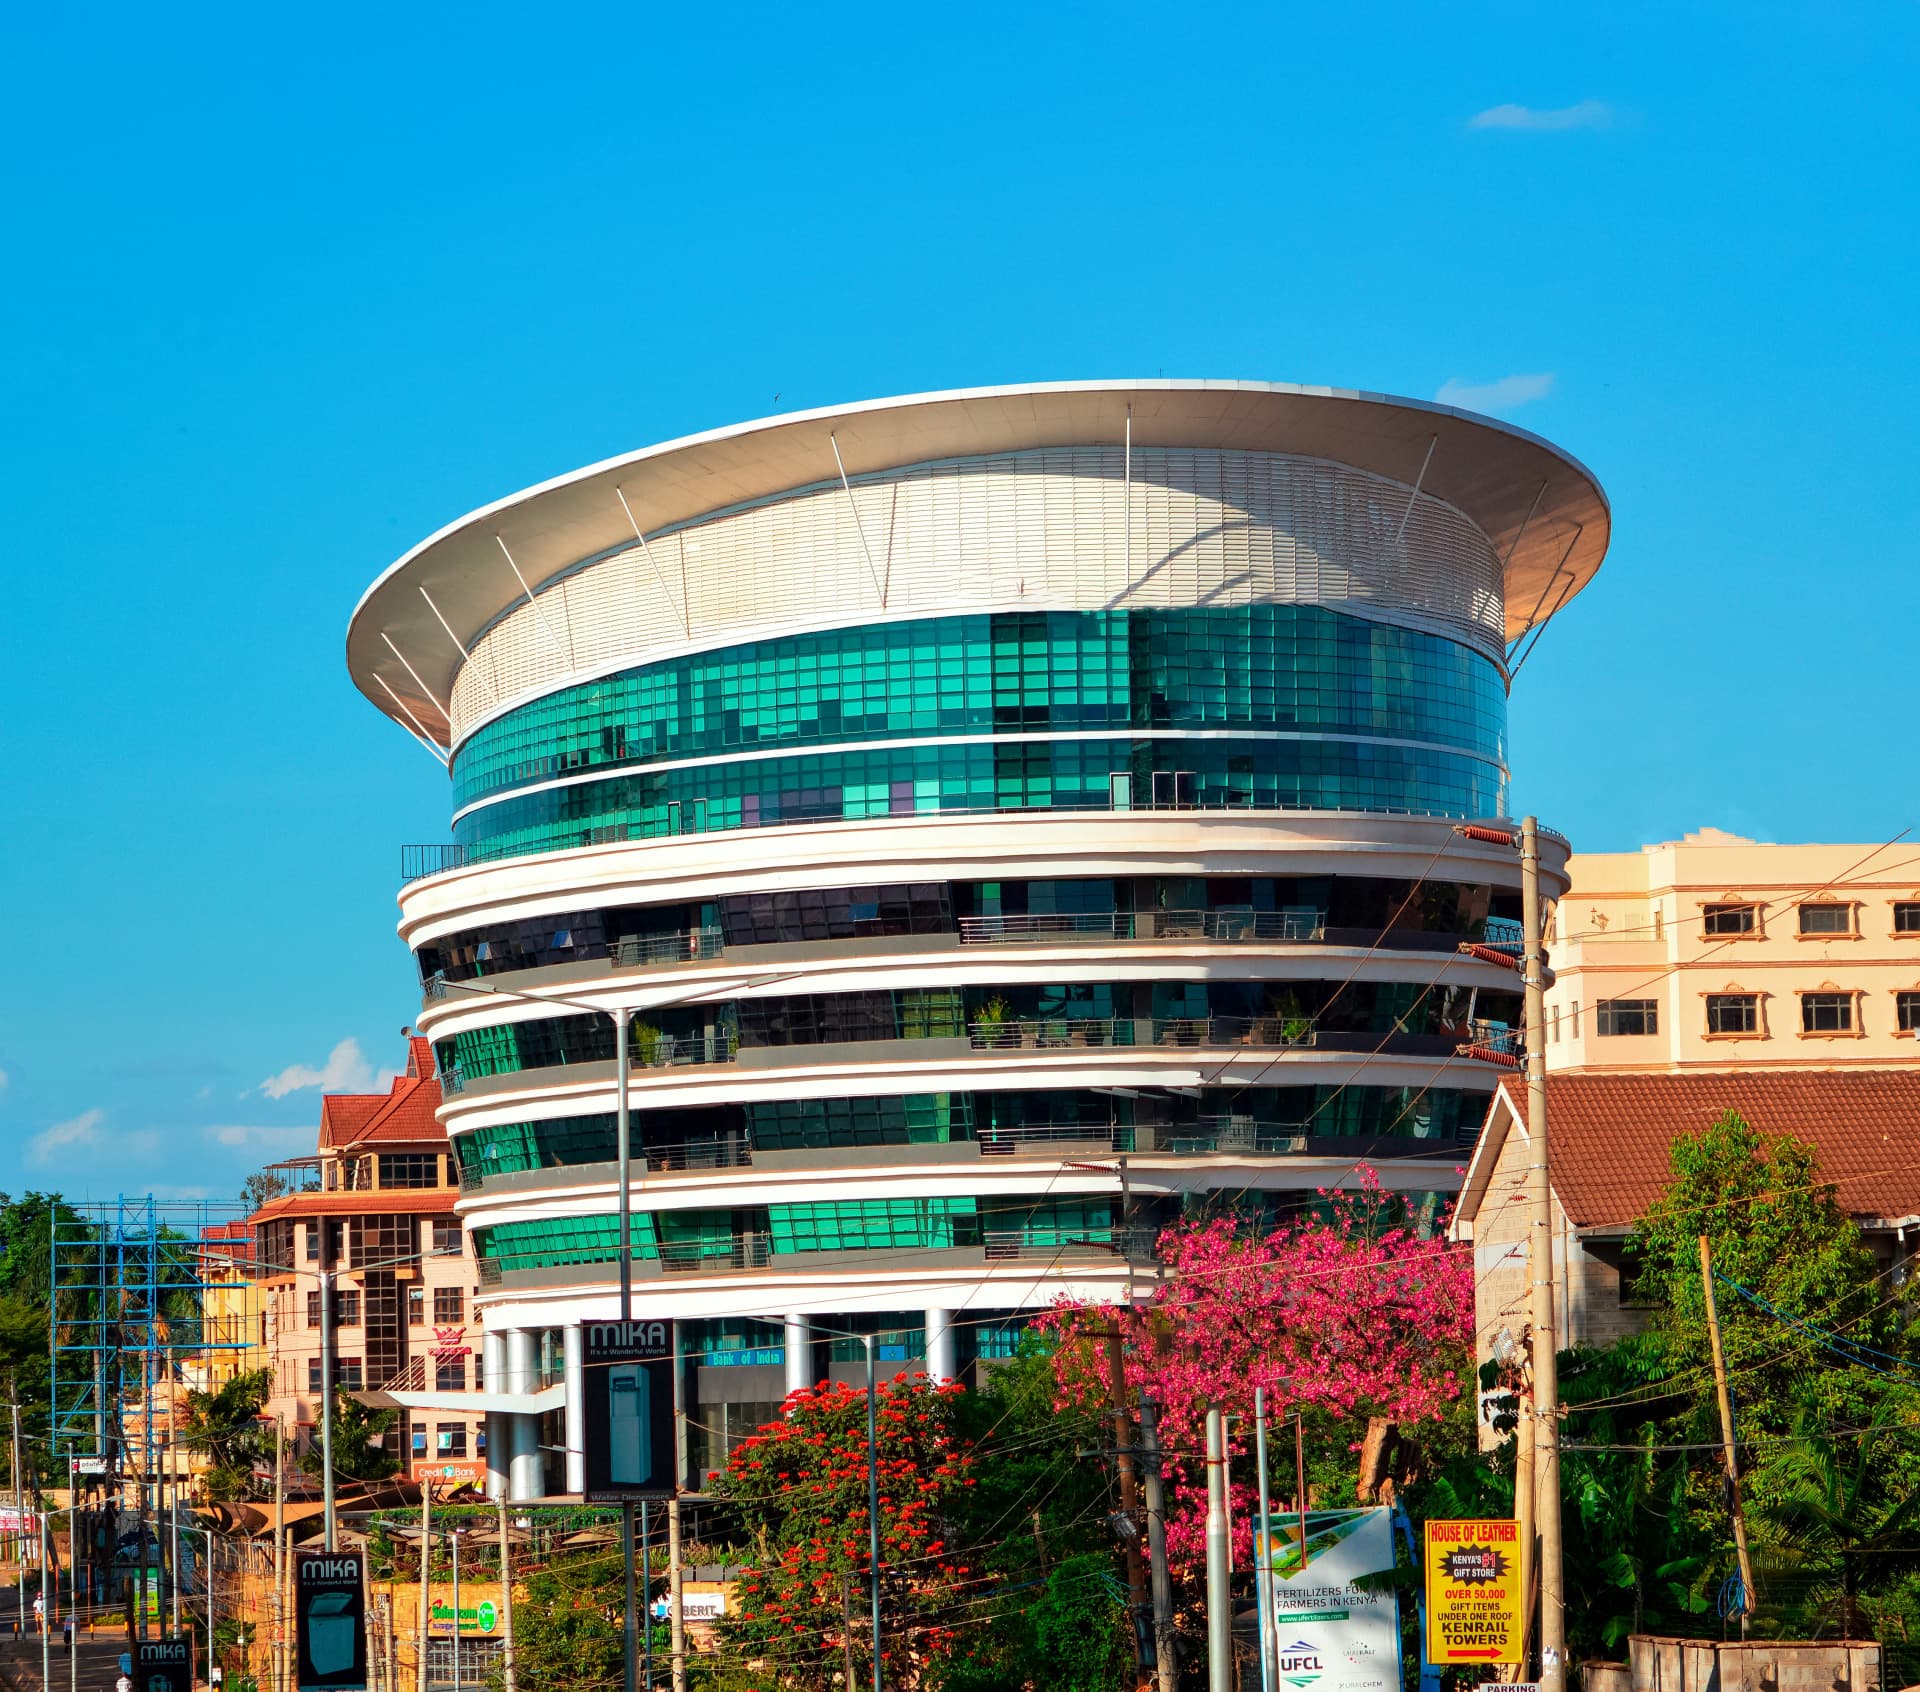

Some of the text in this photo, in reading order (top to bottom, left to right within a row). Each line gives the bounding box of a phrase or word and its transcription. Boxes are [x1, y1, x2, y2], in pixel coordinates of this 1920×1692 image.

[713, 1351, 779, 1365] Bank of India
[418, 1467, 476, 1477] Credit Bank
[1432, 1524, 1516, 1542] HOUSE OF LEATHER
[1452, 1552, 1496, 1568] KENYA'S #1
[1453, 1568, 1496, 1577] GIFT STORE
[1277, 1587, 1342, 1598] FERTILIZERS
[1445, 1589, 1506, 1600] OVER 50,000
[1277, 1595, 1378, 1609] FARMERS IN KENYA
[1450, 1602, 1500, 1611] GIFT ITEMS
[432, 1605, 477, 1619] Safarcom
[667, 1605, 716, 1617] GBERIT
[1438, 1612, 1513, 1621] UNDER ONE ROOF
[1442, 1622, 1510, 1633] KENRAIL
[1444, 1634, 1508, 1645] TOWERS
[1280, 1657, 1323, 1671] UFCL
